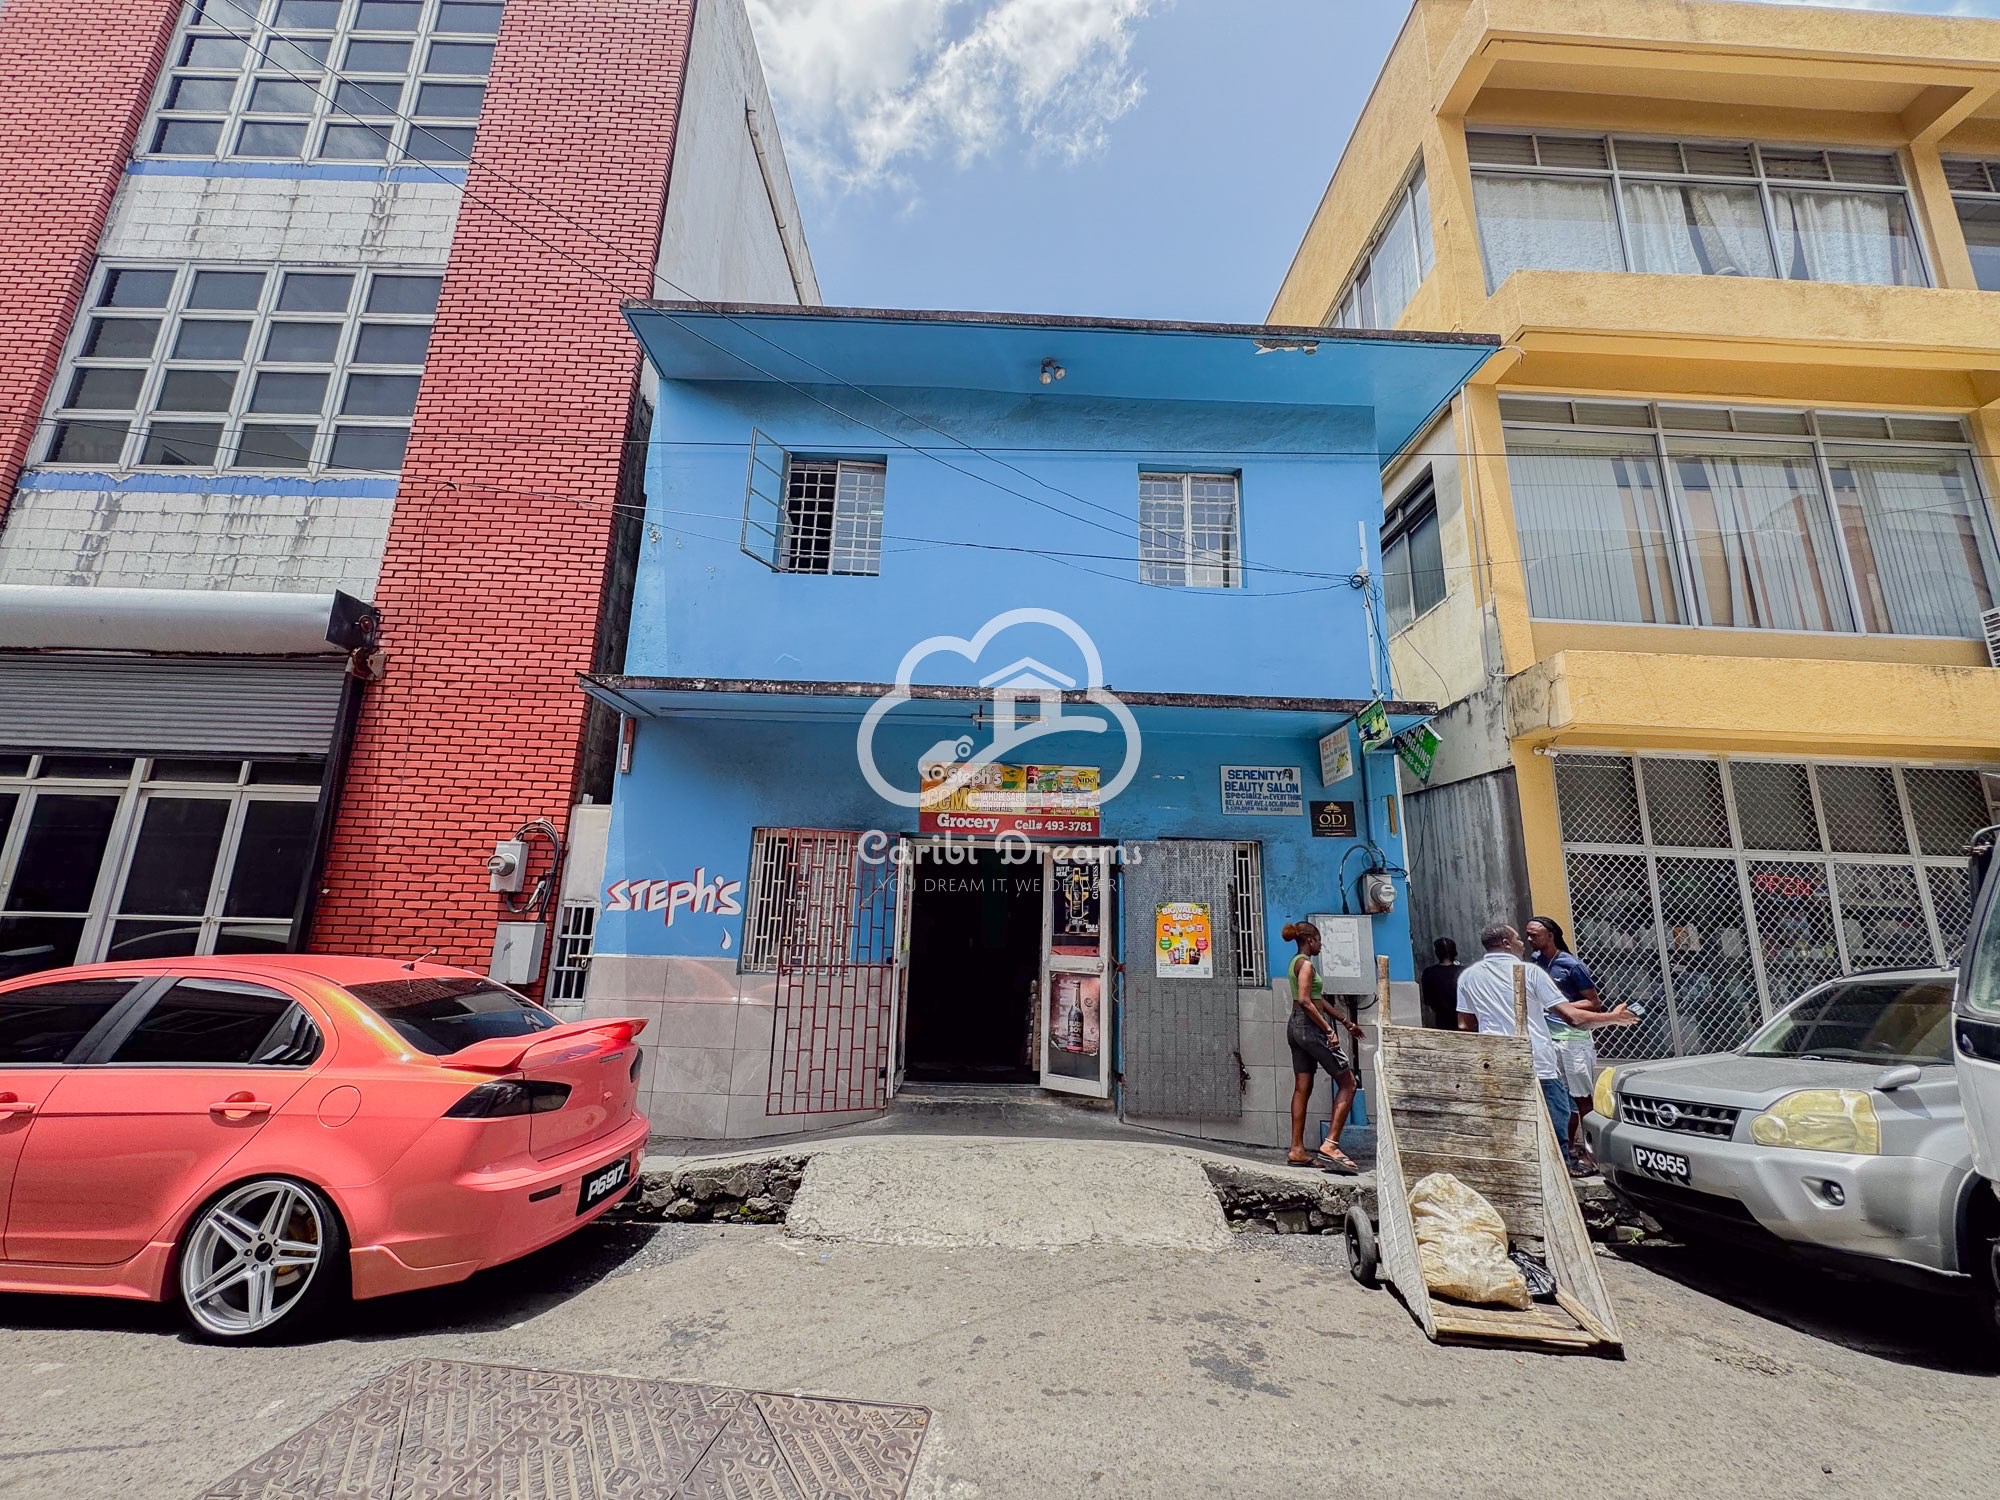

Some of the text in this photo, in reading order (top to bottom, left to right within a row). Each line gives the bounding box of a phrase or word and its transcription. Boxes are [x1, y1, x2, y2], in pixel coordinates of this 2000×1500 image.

[1399, 730, 1431, 767] ARGAINS
[946, 765, 1004, 788] Steph's
[1077, 776, 1096, 784] NIDO
[1227, 769, 1283, 781] SERENITY
[982, 791, 1025, 802] WHOLESALE
[1224, 781, 1299, 794] BEAUTY SALON
[937, 813, 1093, 833] Grocery Cell# 493-3781
[1319, 813, 1347, 827] ODJ
[1162, 905, 1204, 915] BIG VALUE
[1172, 913, 1193, 921] BASH
[1636, 1147, 1687, 1176] PX955
[587, 1162, 626, 1201] P6917
[612, 1412, 633, 1448] DUCTILE
[802, 1432, 833, 1473] DUCTILE
[854, 1445, 883, 1480] BRITON
